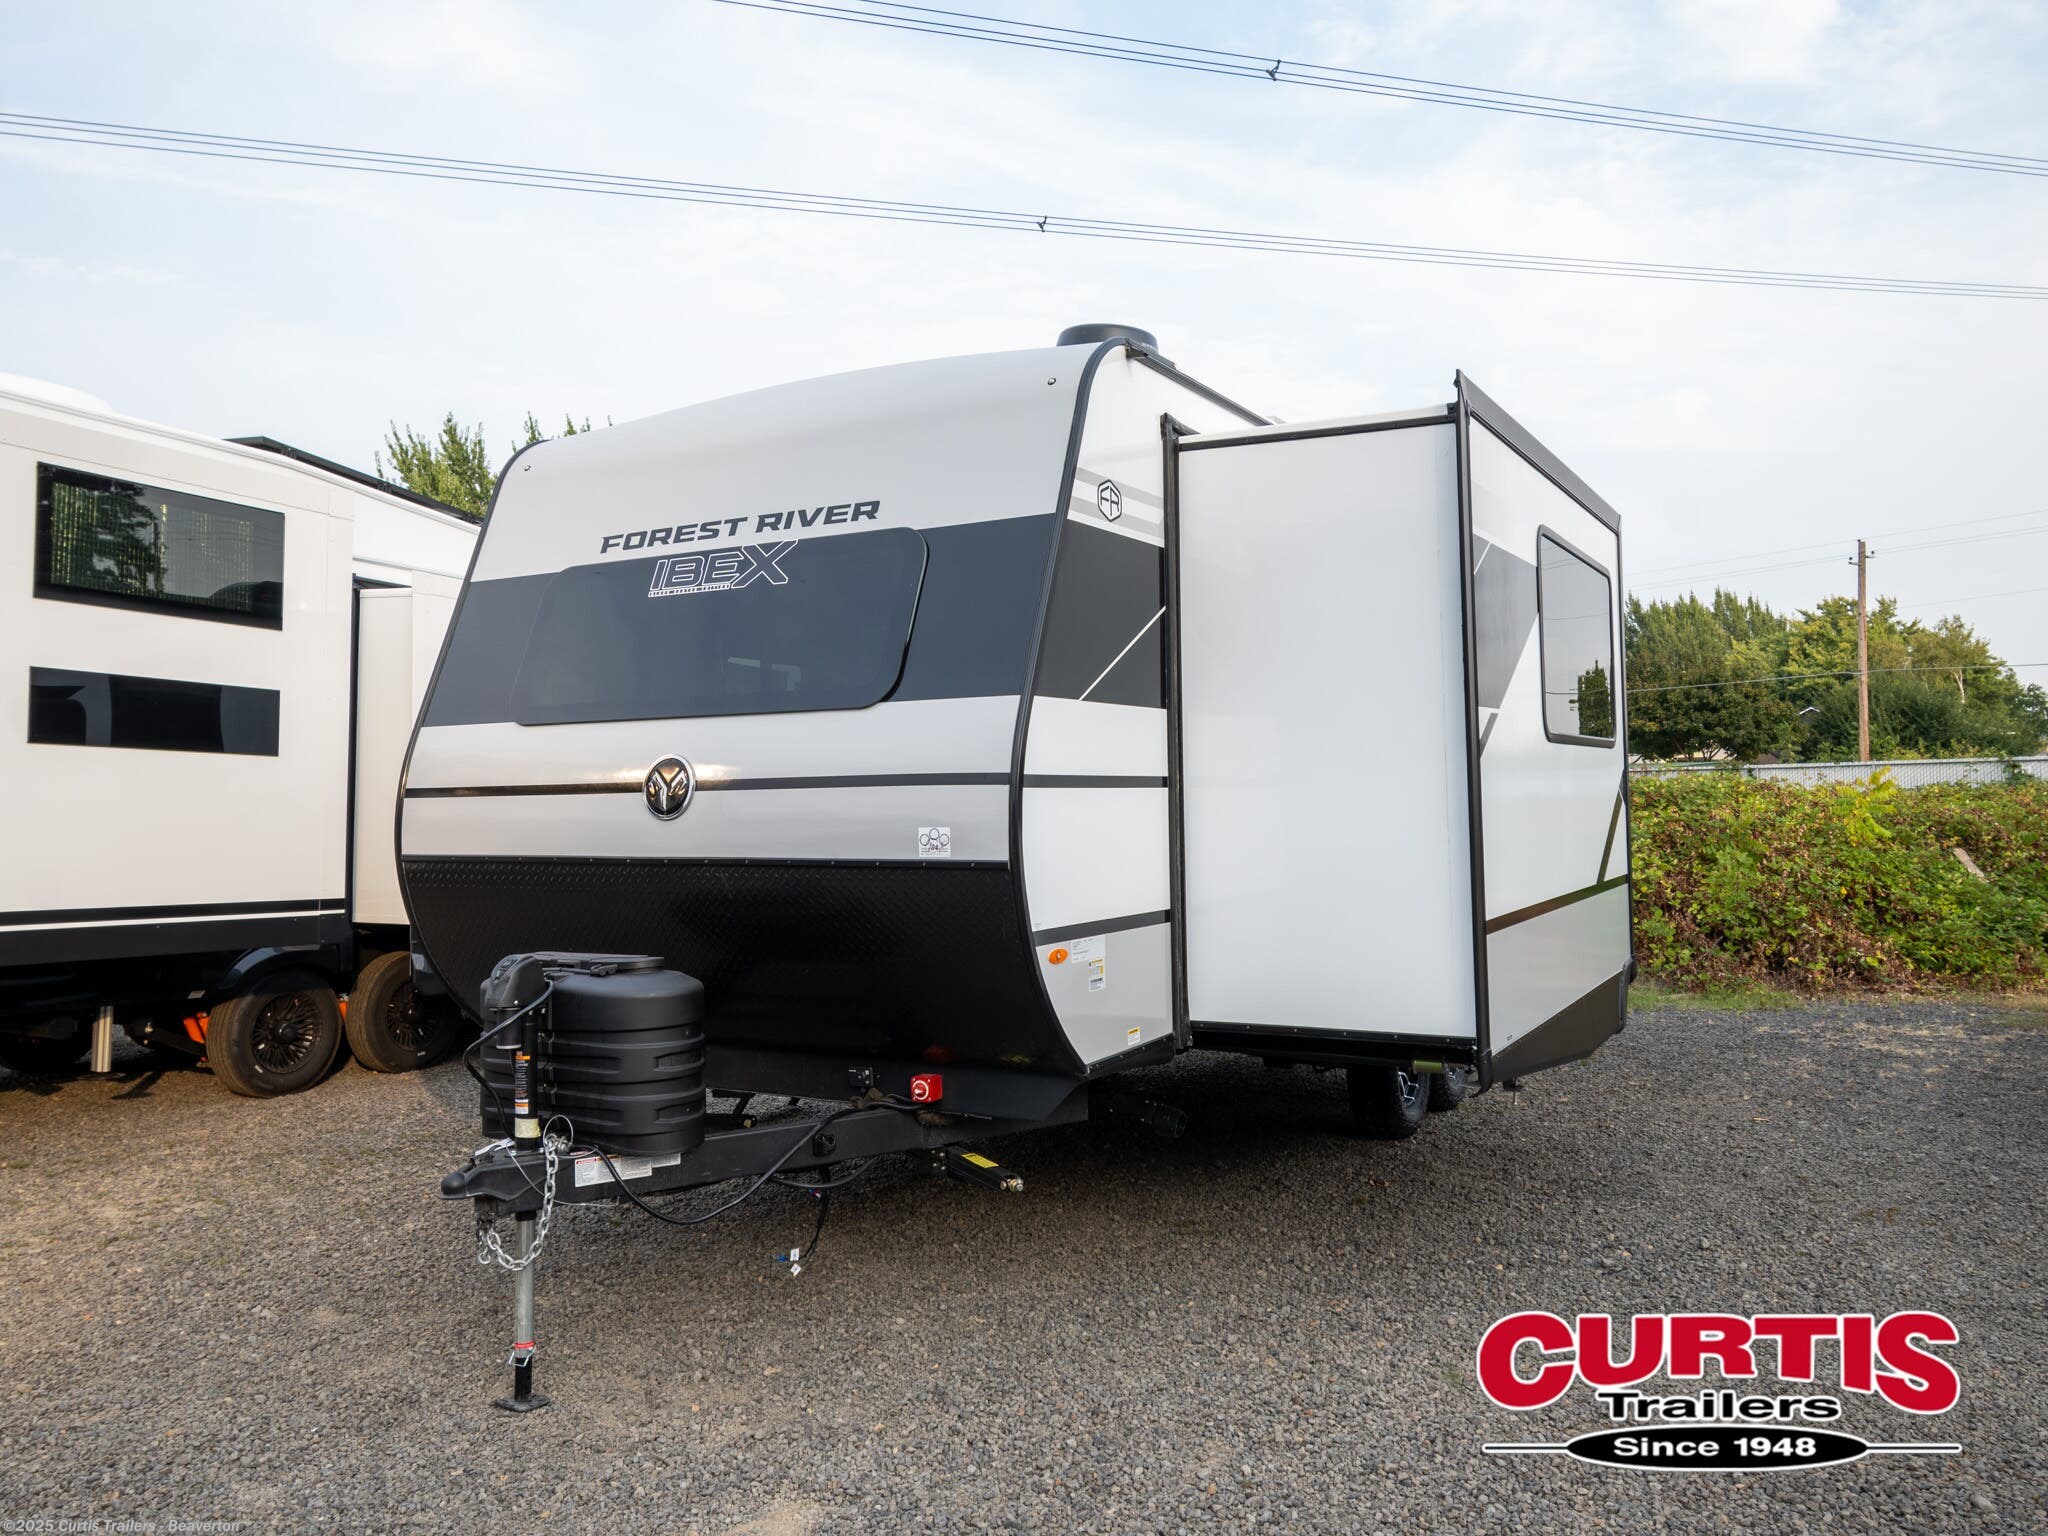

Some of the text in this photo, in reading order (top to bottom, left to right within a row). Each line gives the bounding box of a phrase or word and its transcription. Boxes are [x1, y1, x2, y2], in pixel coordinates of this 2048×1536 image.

[600, 500, 881, 554] FOREST RIVER
[649, 539, 799, 591] IBEX
